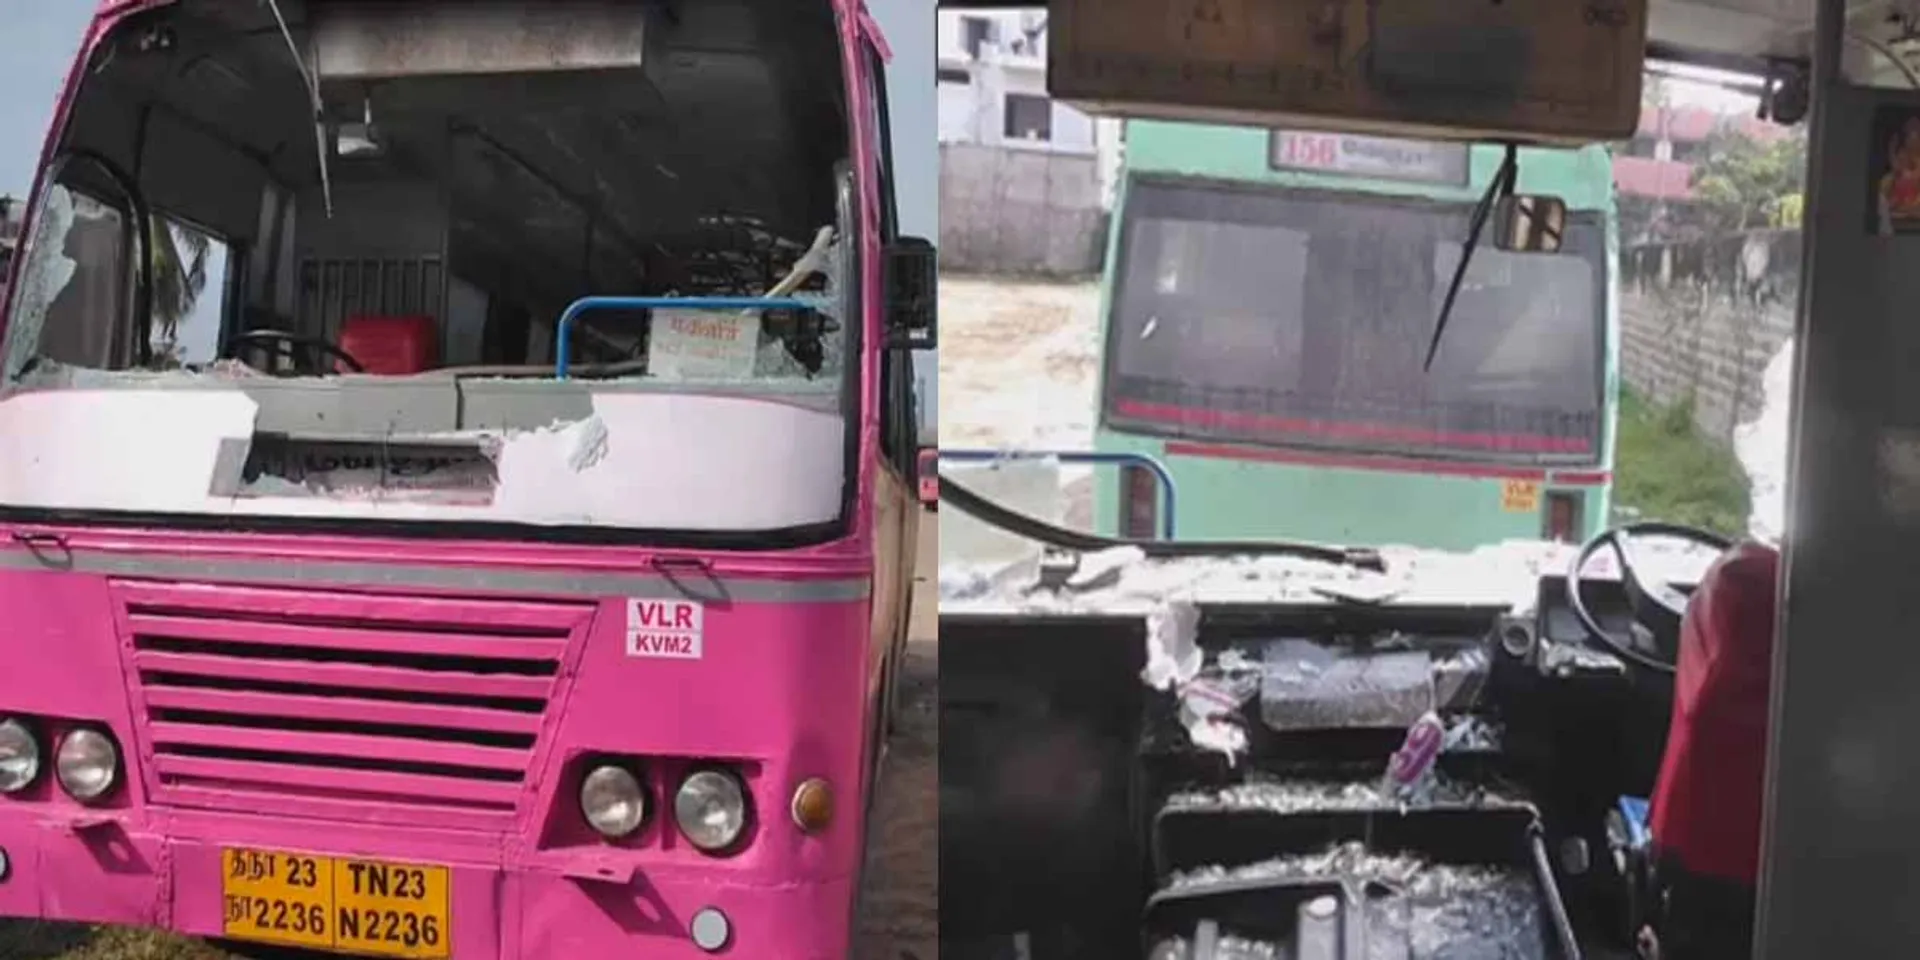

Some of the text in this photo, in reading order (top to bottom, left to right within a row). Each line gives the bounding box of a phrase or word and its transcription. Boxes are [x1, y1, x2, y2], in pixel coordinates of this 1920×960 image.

[1284, 135, 1336, 165] 156
[637, 602, 692, 628] VLR
[636, 634, 692, 654] KVM2
[286, 857, 318, 888] 23
[348, 863, 426, 900] TN23
[339, 907, 439, 947] N2236
